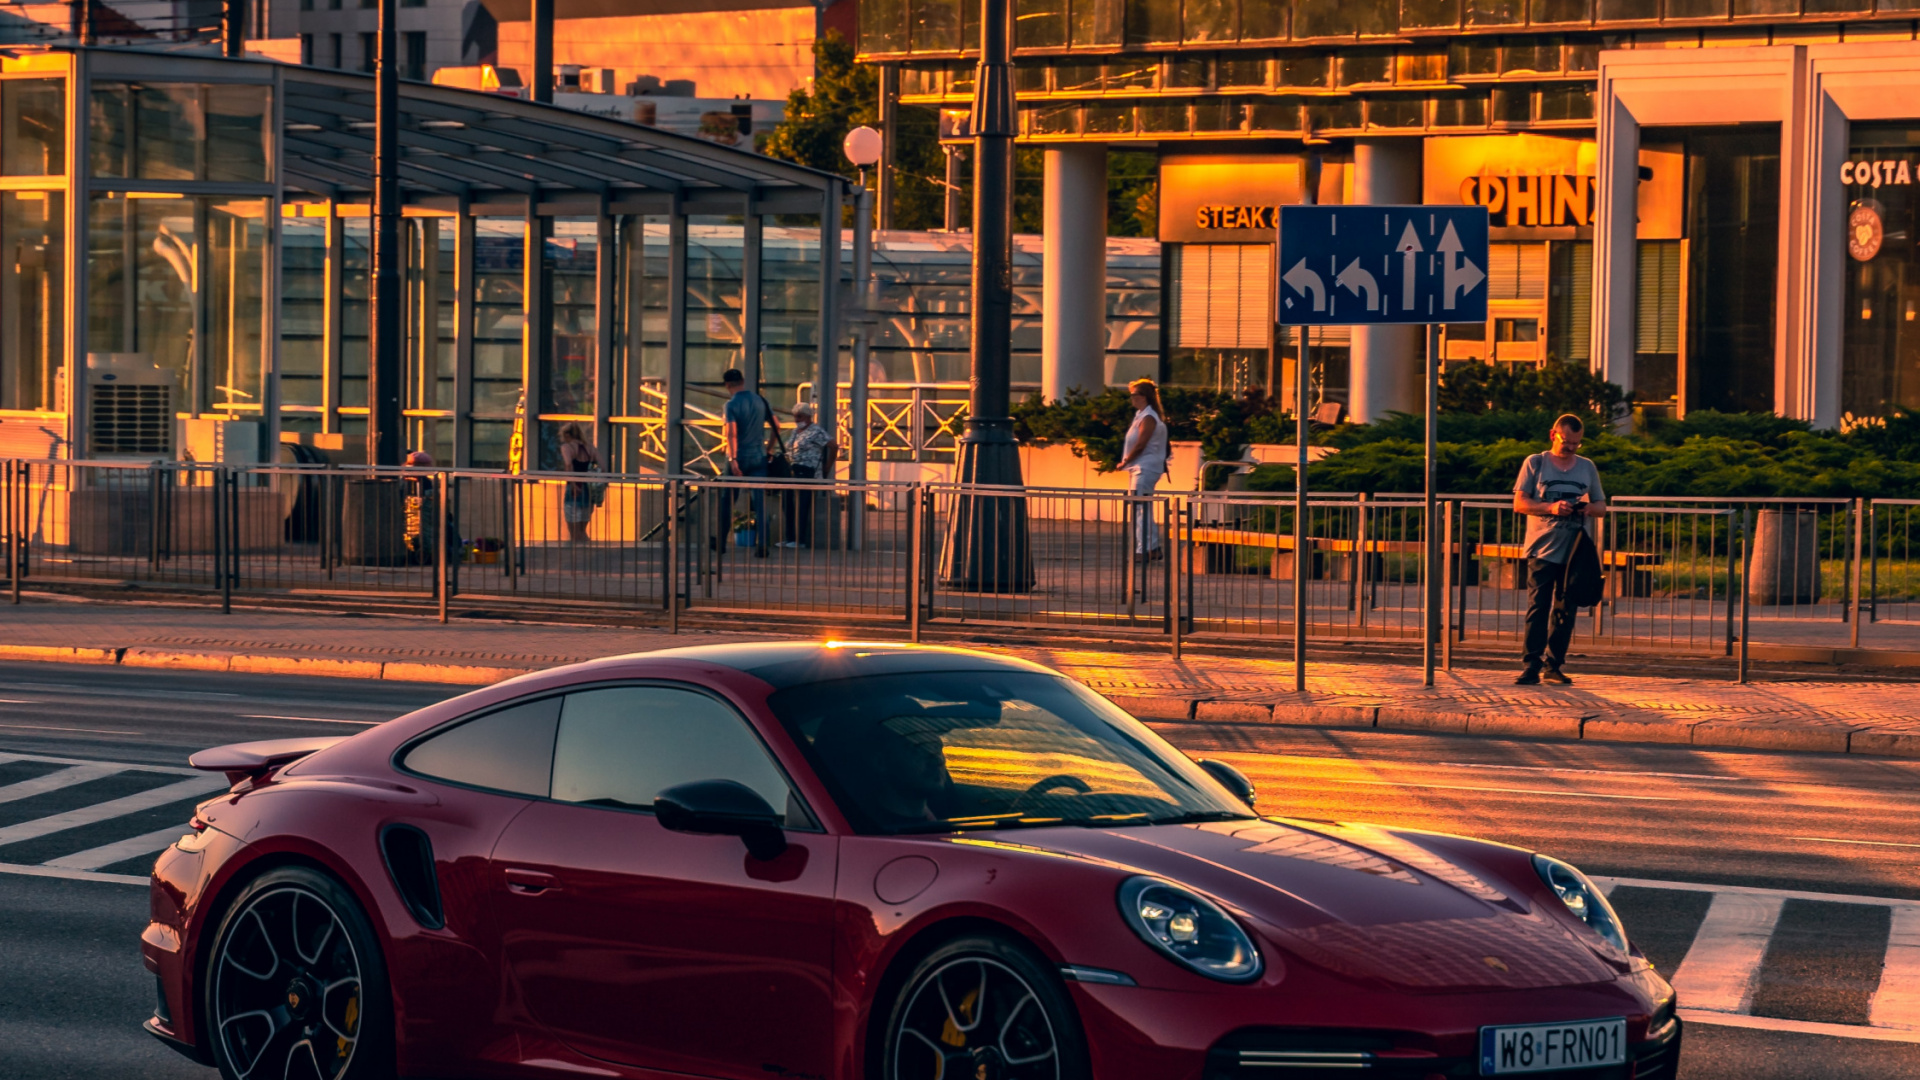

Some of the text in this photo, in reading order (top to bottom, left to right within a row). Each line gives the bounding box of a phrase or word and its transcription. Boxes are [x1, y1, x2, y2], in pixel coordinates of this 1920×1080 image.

[1840, 160, 1911, 188] COSTA
[1196, 206, 1266, 228] STEAK
[1460, 175, 1597, 226] SPHIN
[1501, 1024, 1618, 1068] W8 FRN01
